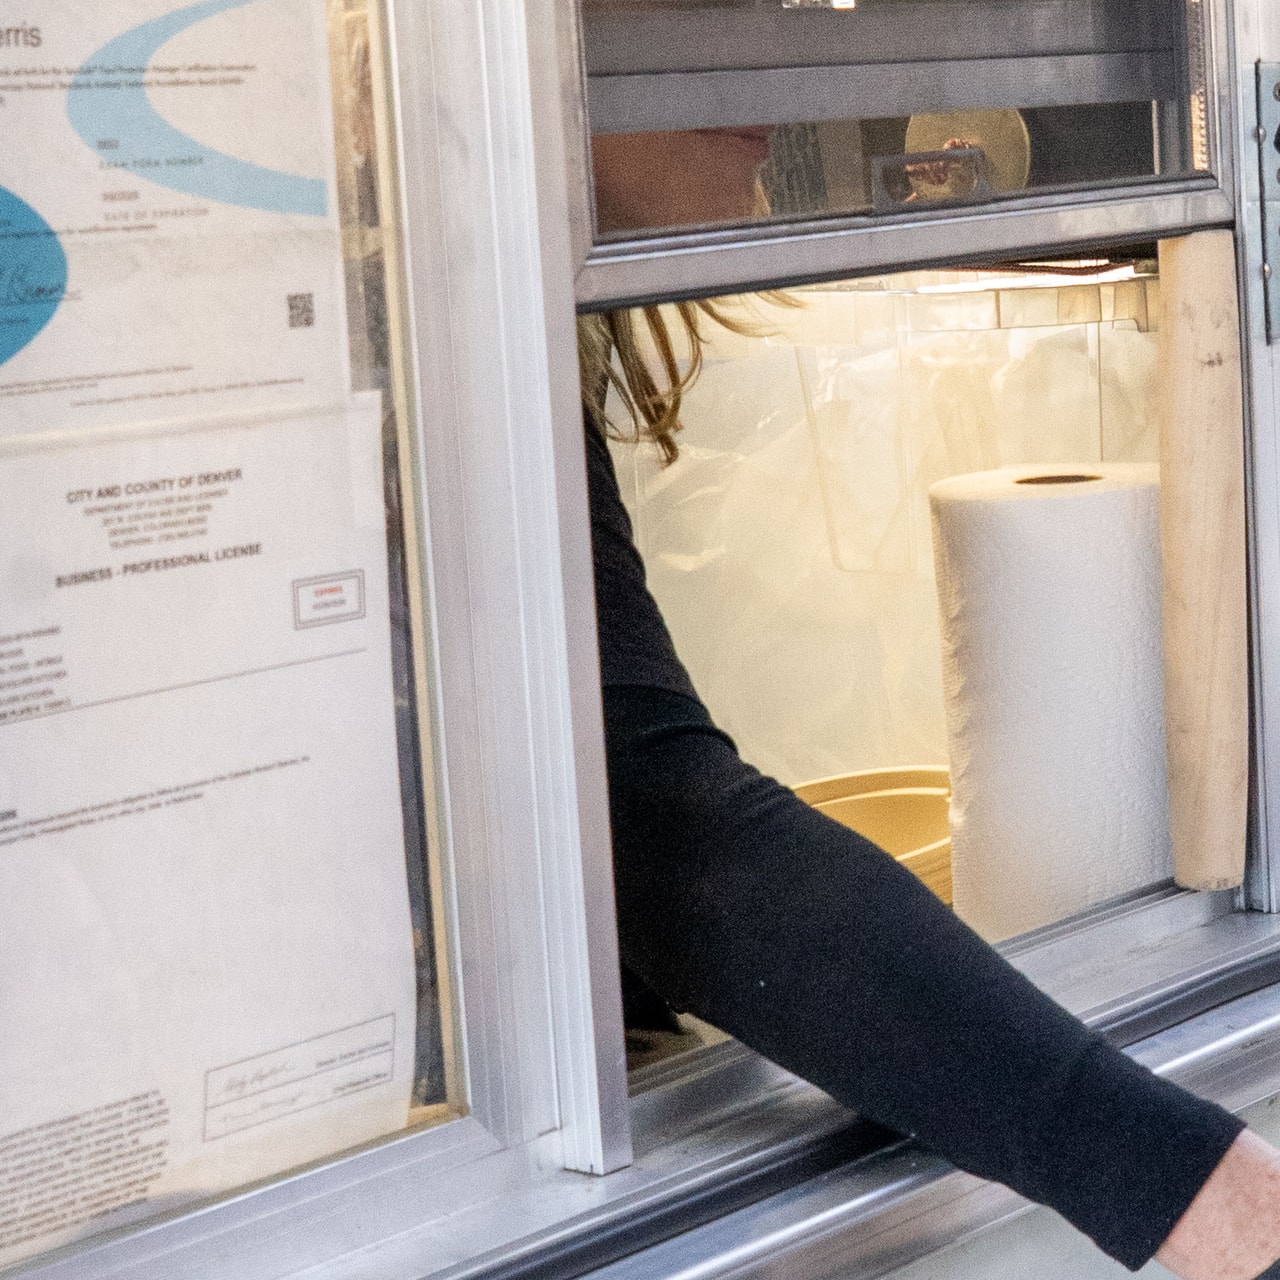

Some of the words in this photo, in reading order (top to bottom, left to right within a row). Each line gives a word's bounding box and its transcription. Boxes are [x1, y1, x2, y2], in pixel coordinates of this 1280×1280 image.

[66, 488, 93, 505] CITY
[96, 485, 121, 499] AND
[124, 478, 175, 495] COUNTY
[178, 475, 194, 489] OF
[197, 468, 243, 485] DENVER
